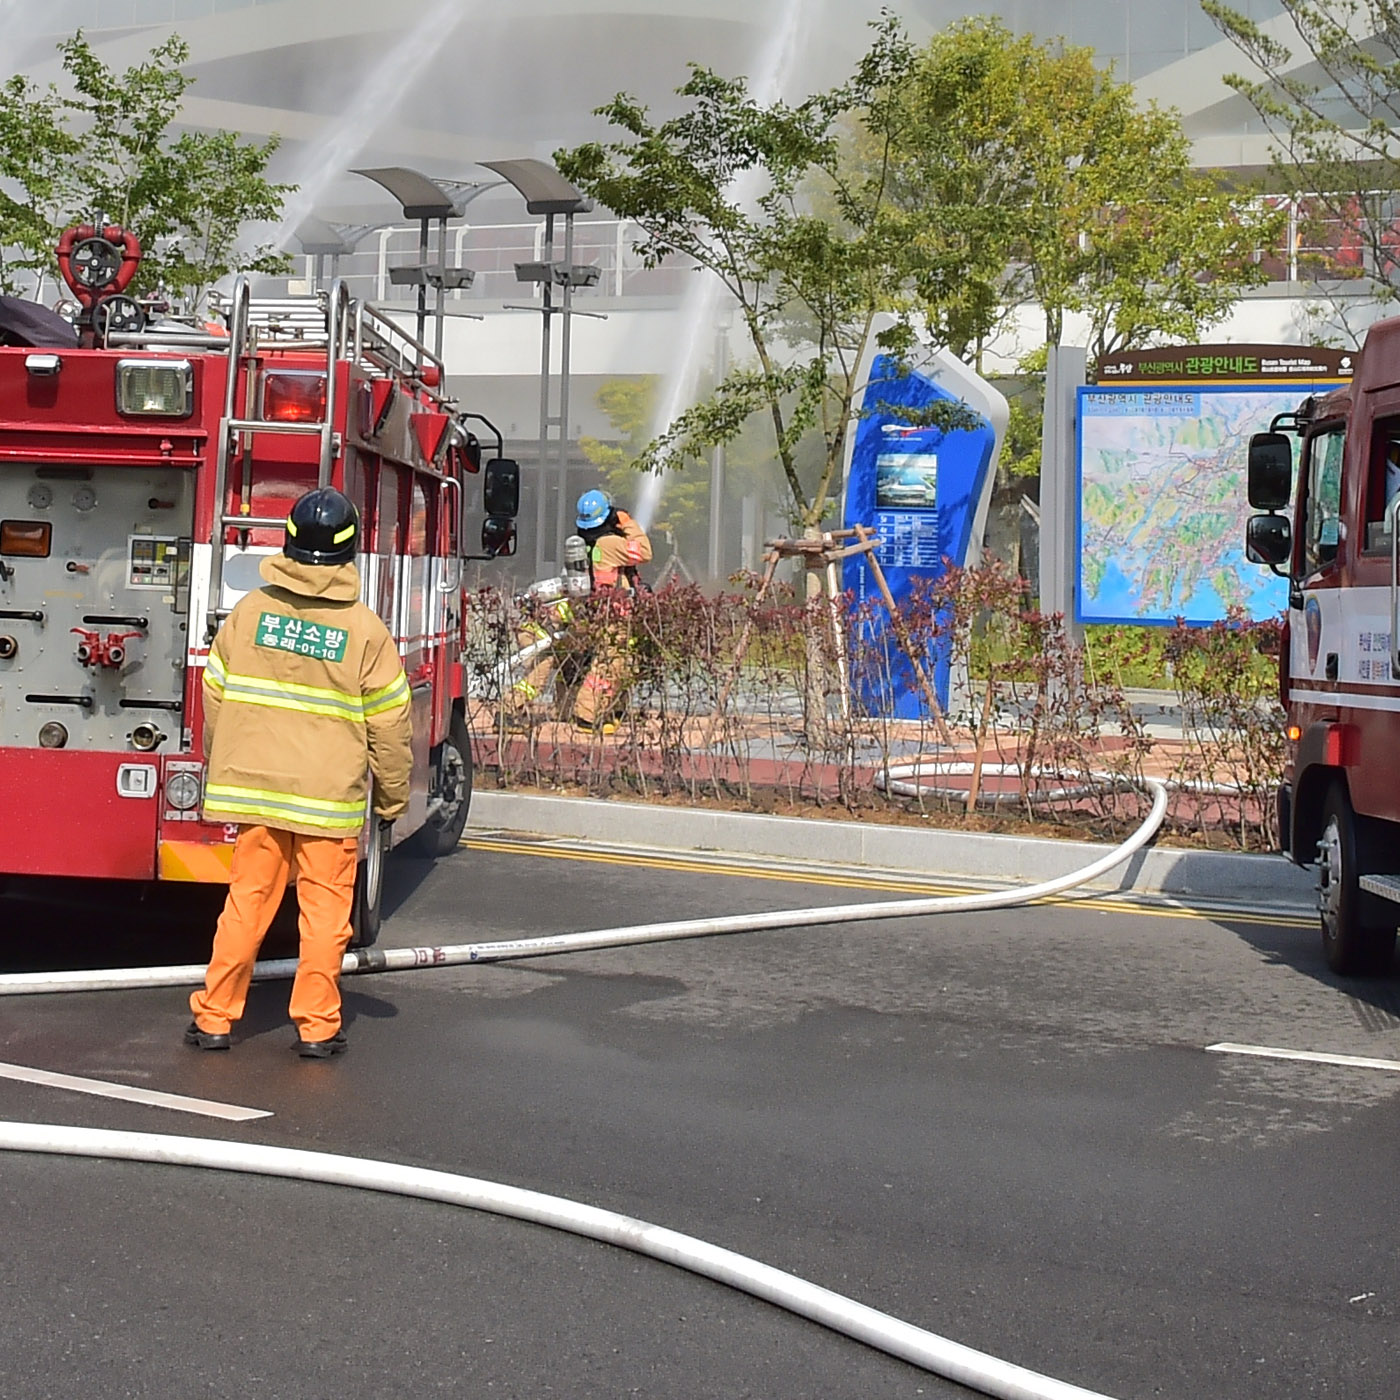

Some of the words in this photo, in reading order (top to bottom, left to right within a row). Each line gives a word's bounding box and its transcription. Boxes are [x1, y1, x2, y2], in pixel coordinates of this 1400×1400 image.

[1138, 362, 1183, 375] 부산광역시
[1186, 356, 1258, 375] 관광안내도
[261, 614, 344, 648] 부산소방
